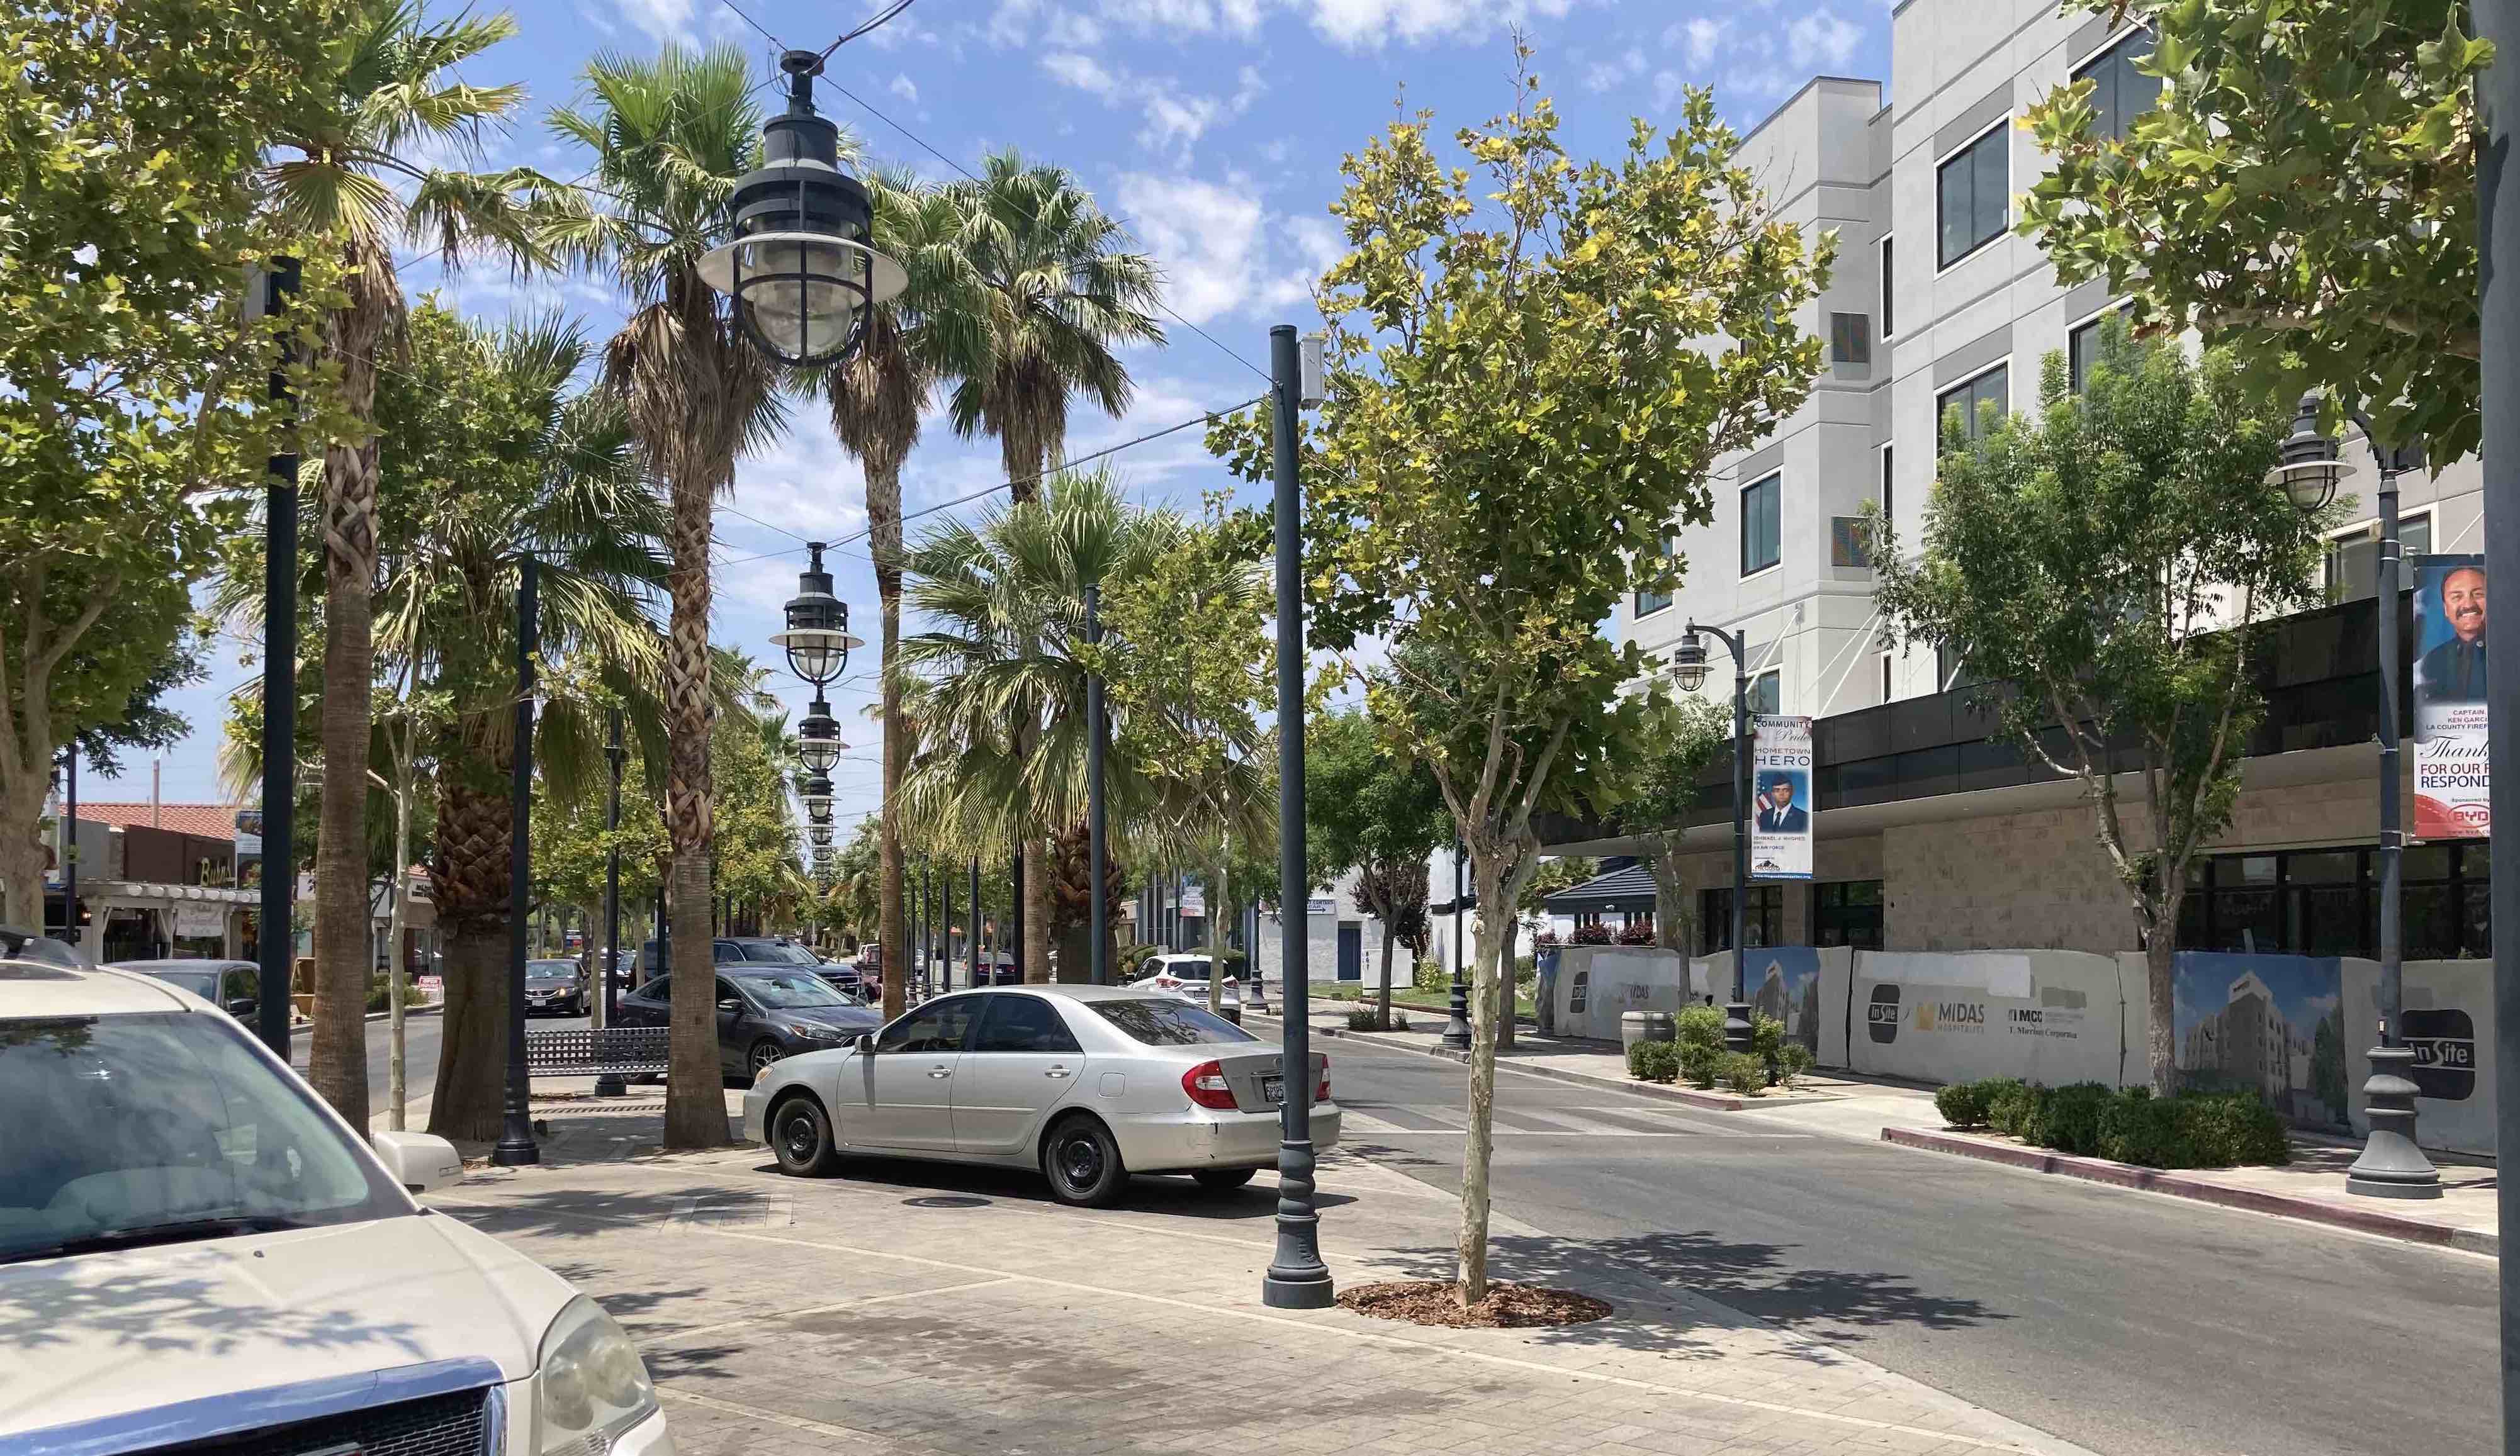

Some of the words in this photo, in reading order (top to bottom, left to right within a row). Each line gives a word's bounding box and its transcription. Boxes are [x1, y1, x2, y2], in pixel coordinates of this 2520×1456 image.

[1756, 720, 1809, 729] COMMUNITY
[1755, 755, 1810, 766] HERO
[2421, 763, 2447, 775] FOR
[2451, 763, 2480, 775] OUR
[2453, 811, 2489, 821] BYD
[1938, 1003, 1984, 1024] MIDAS
